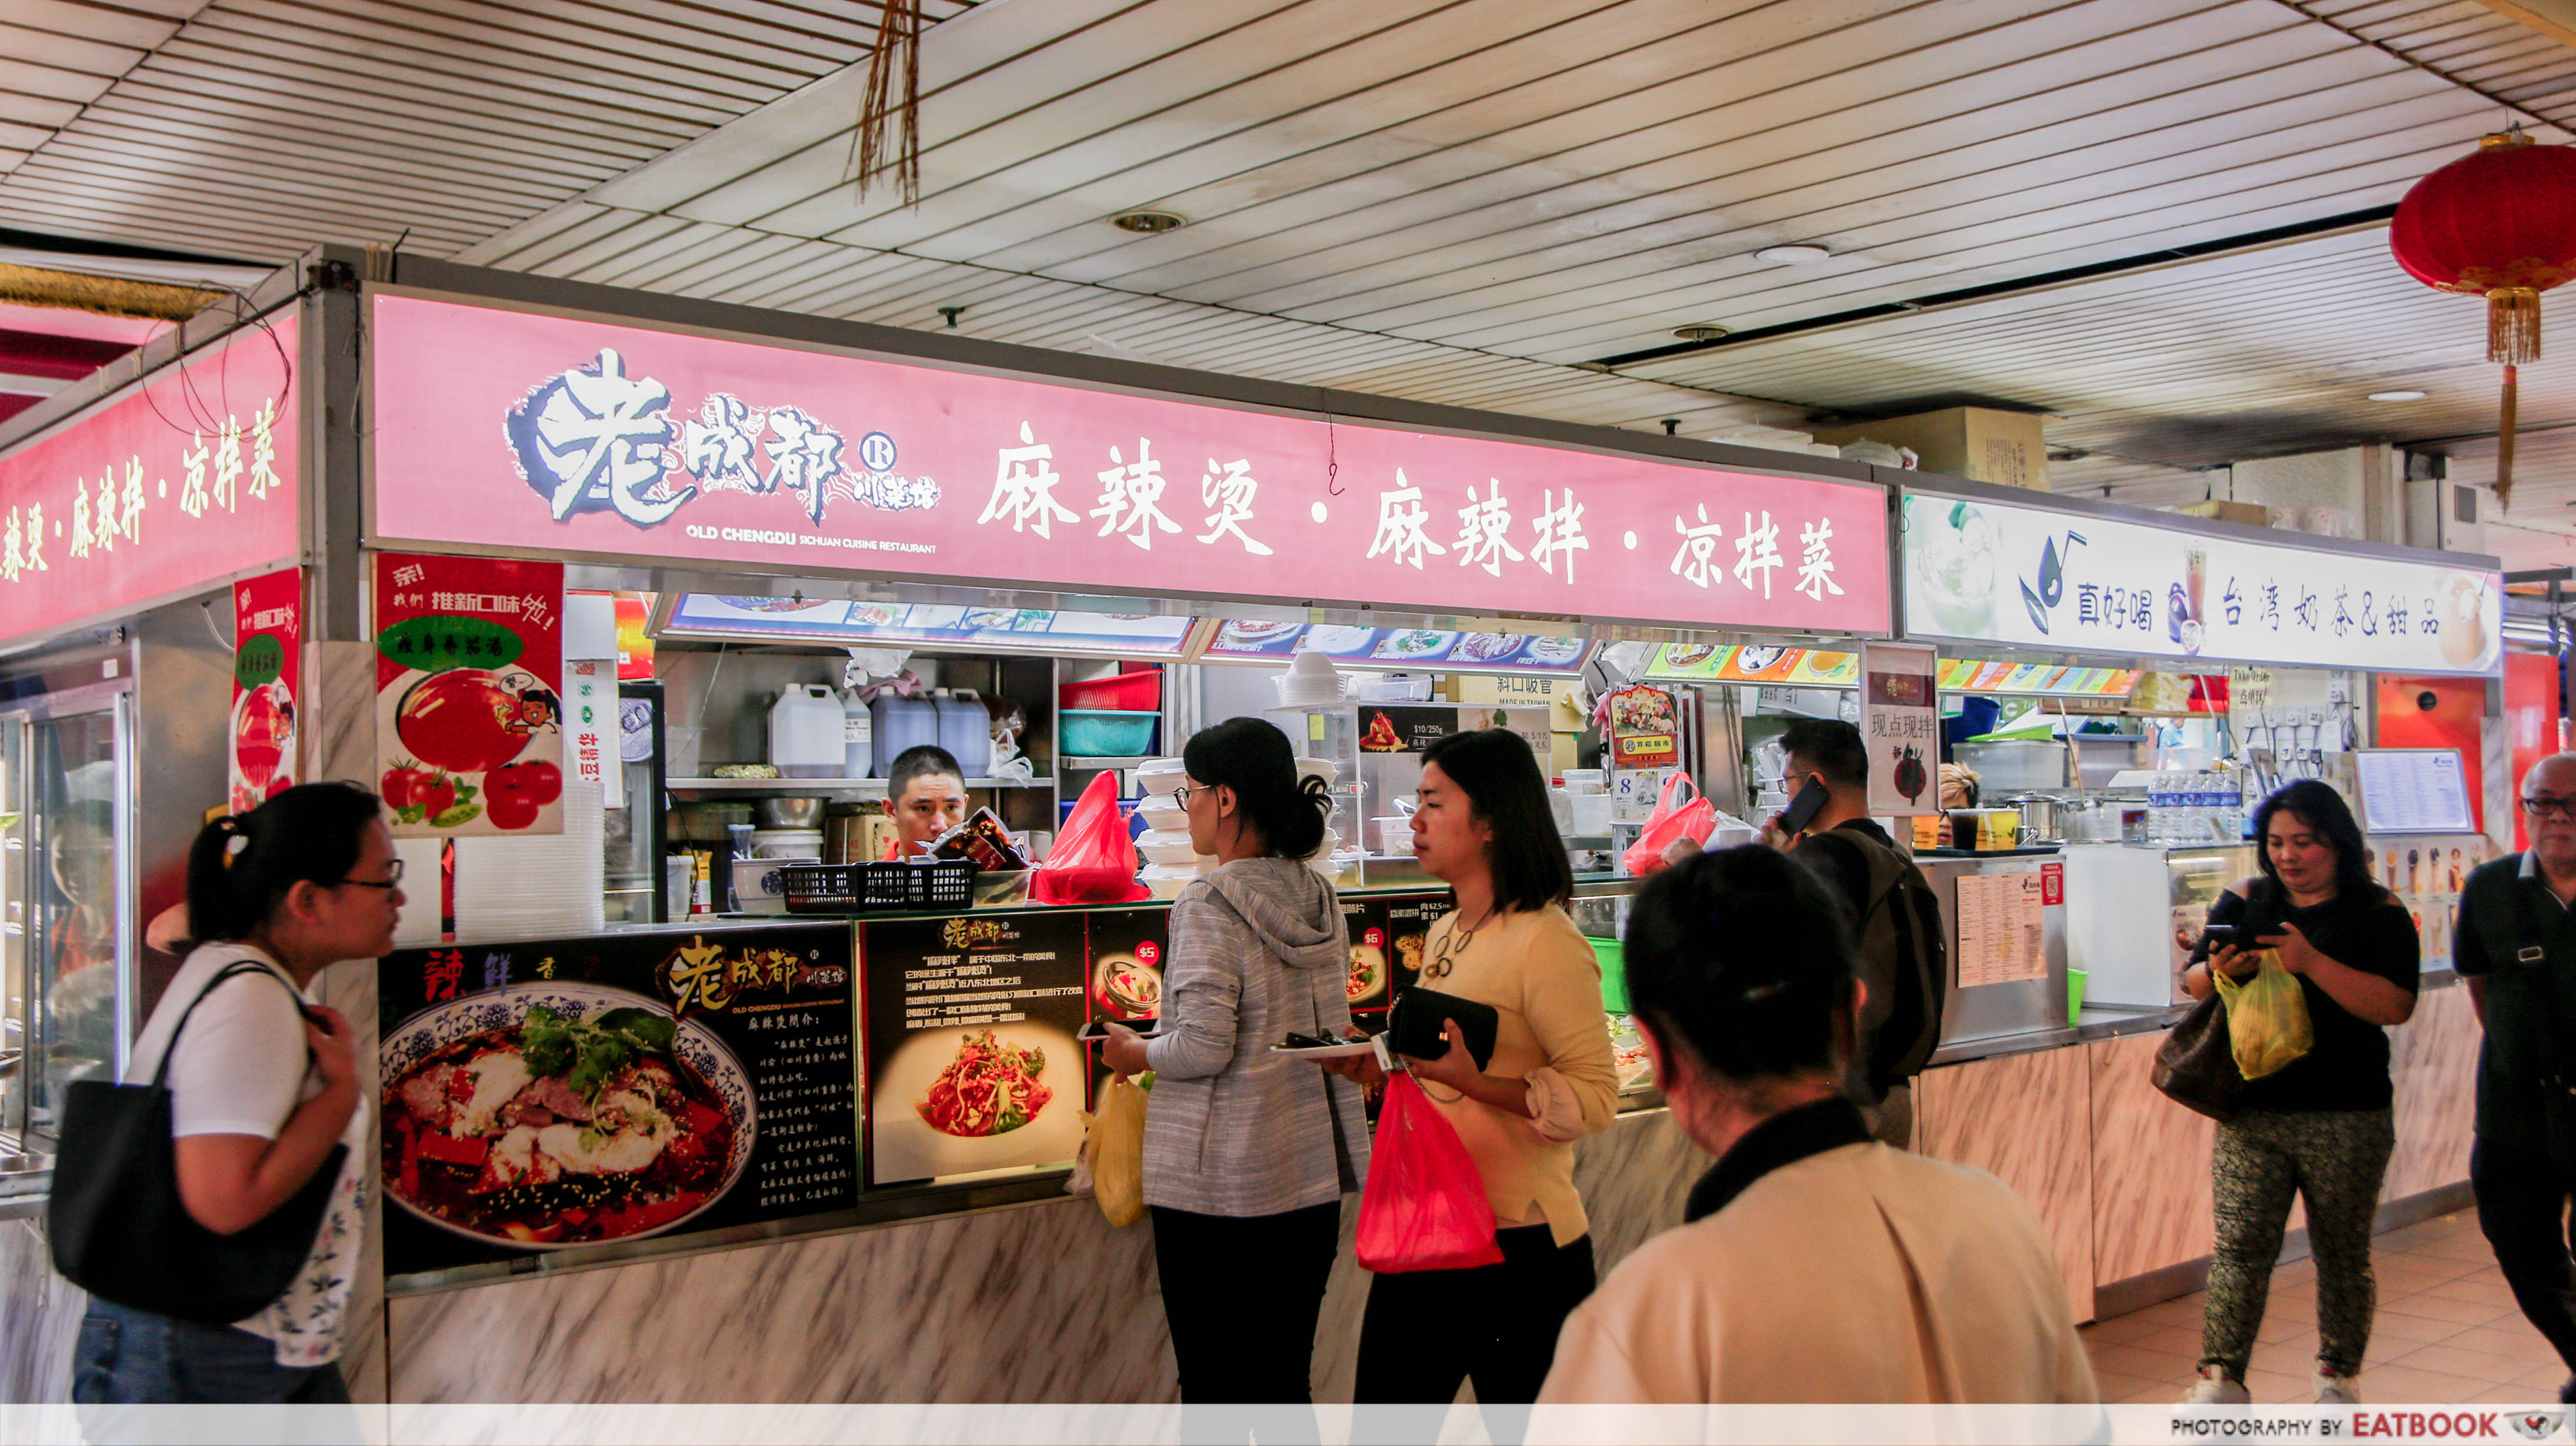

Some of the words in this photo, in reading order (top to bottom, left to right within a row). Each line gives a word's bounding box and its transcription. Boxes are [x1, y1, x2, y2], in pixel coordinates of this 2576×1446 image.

[535, 347, 844, 527] 老成都
[685, 525, 718, 539] OLD
[721, 528, 797, 545] CHENGDU
[799, 535, 841, 548] SICHUAN
[843, 539, 877, 550] CUISINE
[879, 541, 937, 554] RESTAURANT
[431, 591, 521, 613] 推新口味
[2078, 582, 2152, 632] 真好喝
[2234, 669, 2250, 681] Take
[2251, 670, 2270, 682] Order
[1497, 676, 1552, 694] 斜口吸管
[2239, 688, 2264, 705] 点单区
[1414, 724, 1443, 734] $10/250g
[1872, 713, 1934, 739] 现点现拌
[578, 733, 600, 782] 豆精华
[1620, 778, 1631, 795] 8
[1430, 912, 1438, 920] $1
[1364, 933, 1378, 944] $6
[1139, 946, 1156, 958] $5
[423, 948, 467, 1002] 辣
[535, 957, 557, 979] 香
[669, 934, 799, 1014] 老成都
[748, 1004, 781, 1012] CHENGDU
